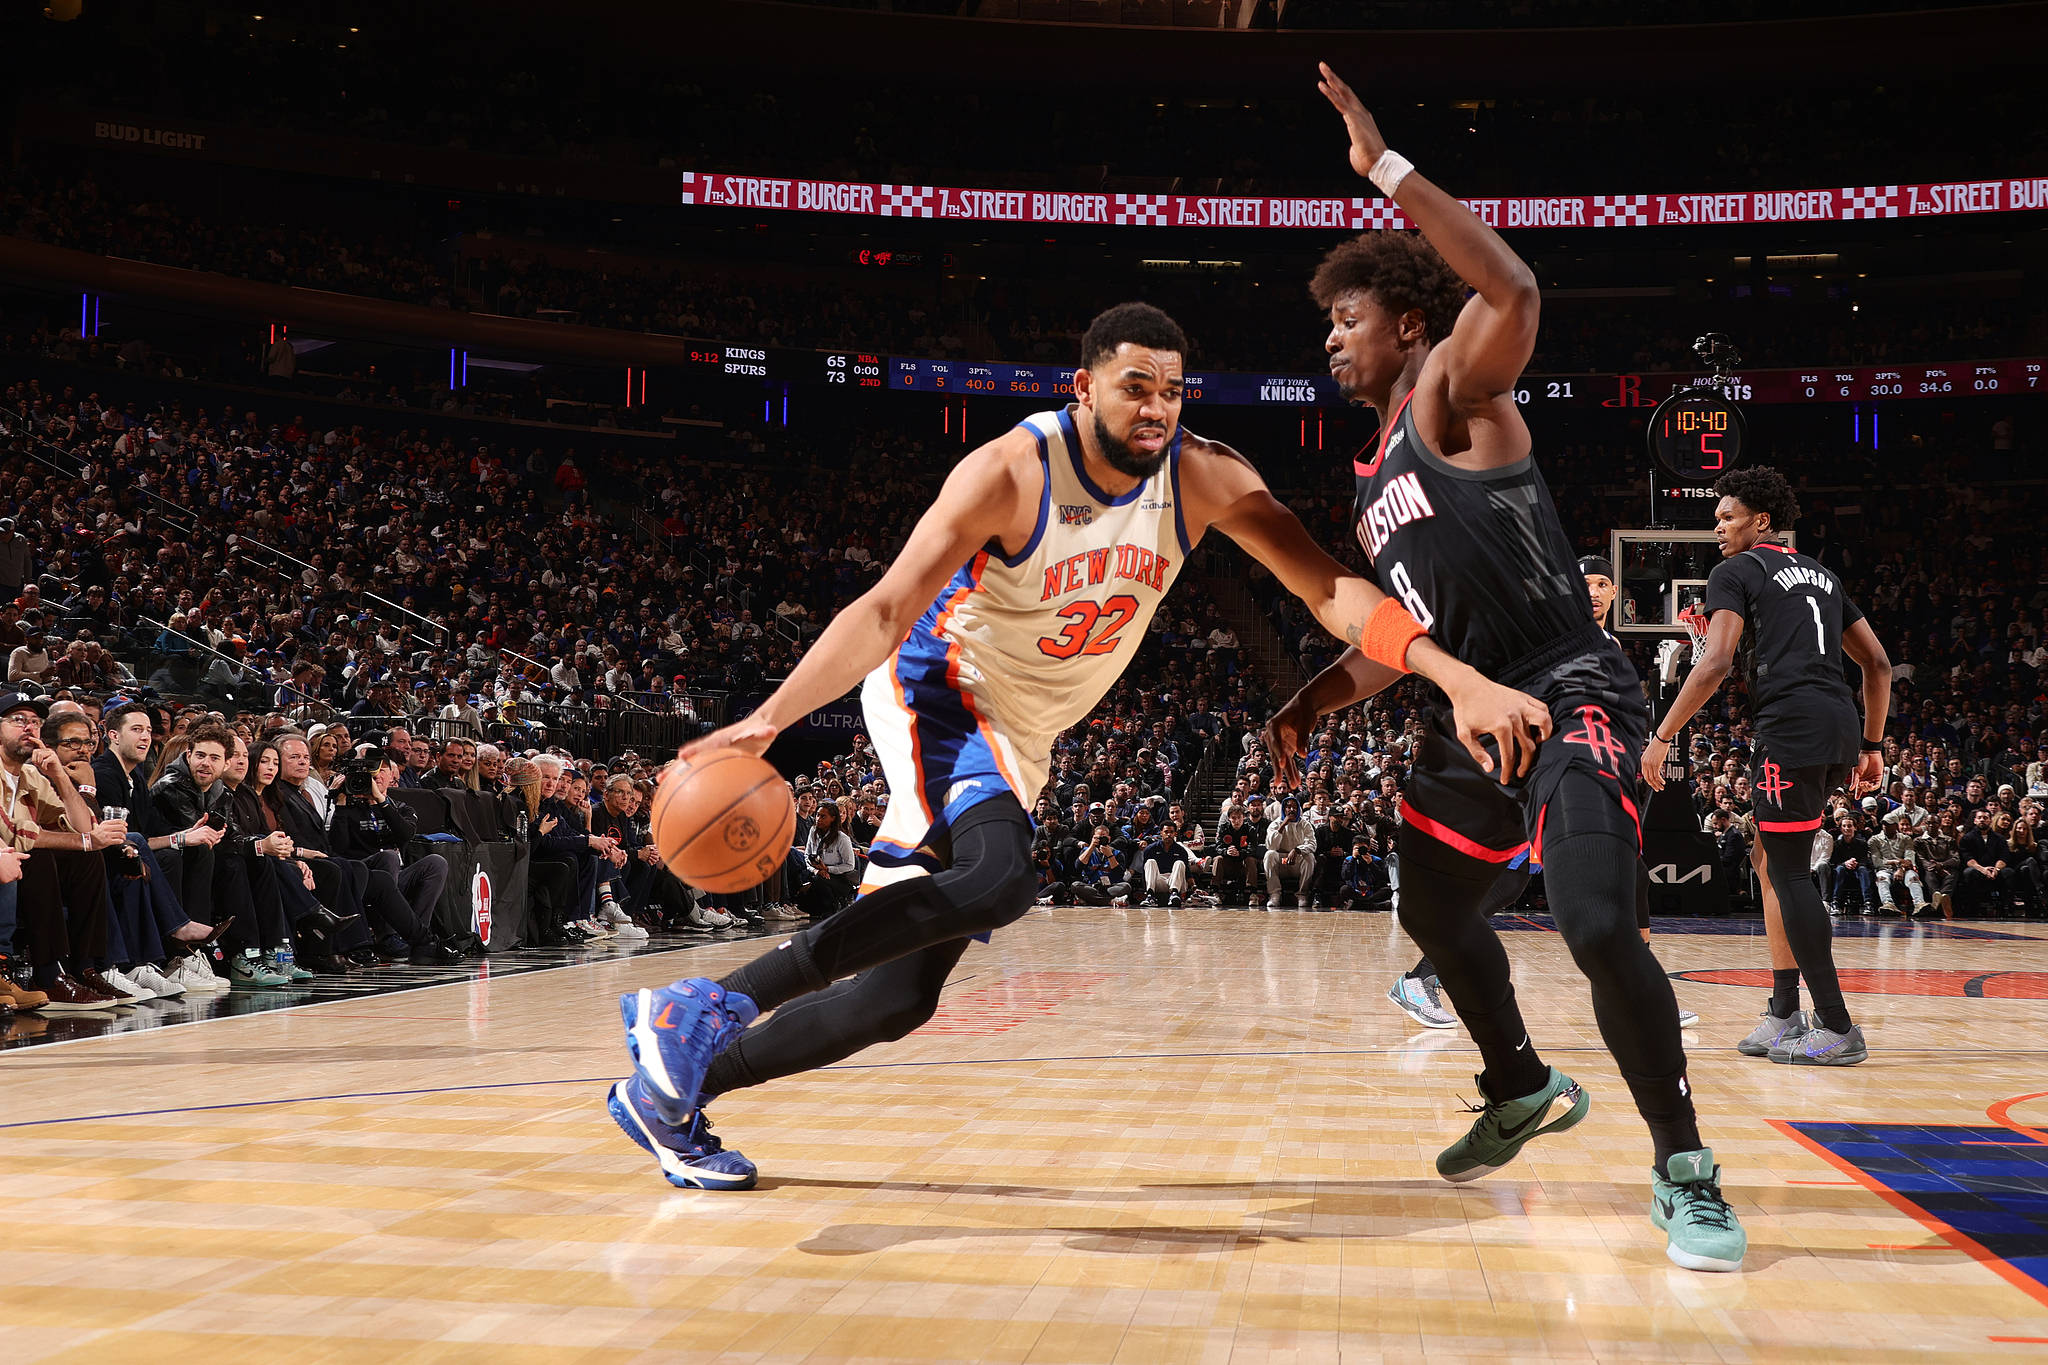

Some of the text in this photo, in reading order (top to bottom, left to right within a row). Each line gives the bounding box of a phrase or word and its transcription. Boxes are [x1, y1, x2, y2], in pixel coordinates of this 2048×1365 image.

[95, 121, 206, 150] BUD LIGHT
[724, 177, 792, 208] STREET
[797, 181, 874, 213] BURGER
[1930, 182, 2003, 214] STREET
[960, 190, 1026, 219] STREET
[1032, 193, 1108, 222] BURGER
[1197, 198, 1263, 226] STREET
[1269, 199, 1345, 227] BURGER
[1507, 198, 1586, 227] BURGER
[1678, 194, 1747, 223] STREET
[1753, 191, 1834, 221] BURGER
[690, 351, 719, 364] 9:12
[725, 347, 766, 361] KINGS
[826, 356, 846, 368] 65
[857, 354, 879, 364] NBA
[724, 363, 766, 376] SPURS
[826, 371, 846, 383] 73
[853, 365, 879, 376] 0:00
[900, 363, 916, 371] FLS
[931, 365, 949, 373] TOL
[968, 368, 992, 376] 3PT%
[1015, 370, 1034, 378] FG%
[1185, 377, 1203, 385] REB
[1800, 367, 1997, 383] FLS TOL 3PT% FG% FT%
[2025, 364, 2041, 372] TO
[859, 377, 881, 387] 2ND
[904, 375, 913, 385] 0
[936, 377, 945, 388] 5
[965, 379, 995, 391] 40.0
[1010, 381, 1040, 393] 56.0
[1185, 388, 1202, 399] 10
[1266, 378, 1311, 387] NEW YORK
[1547, 381, 1574, 398] 21
[1805, 376, 2039, 398] 0 6 30.0 34.6 0.0 7
[1260, 385, 1316, 402] KNICKS
[1677, 411, 1728, 431] 10:40
[1700, 433, 1724, 470] 5
[1681, 487, 1720, 498] TISS
[1059, 504, 1092, 526] NYC
[1040, 543, 1170, 602] NEW YORK
[1772, 566, 1833, 595] THOMPSON
[1390, 560, 1435, 631] 8
[1037, 595, 1140, 660] 32
[1805, 595, 1826, 655] 1
[809, 712, 864, 729] ULTRA
[1666, 763, 1685, 782] App
